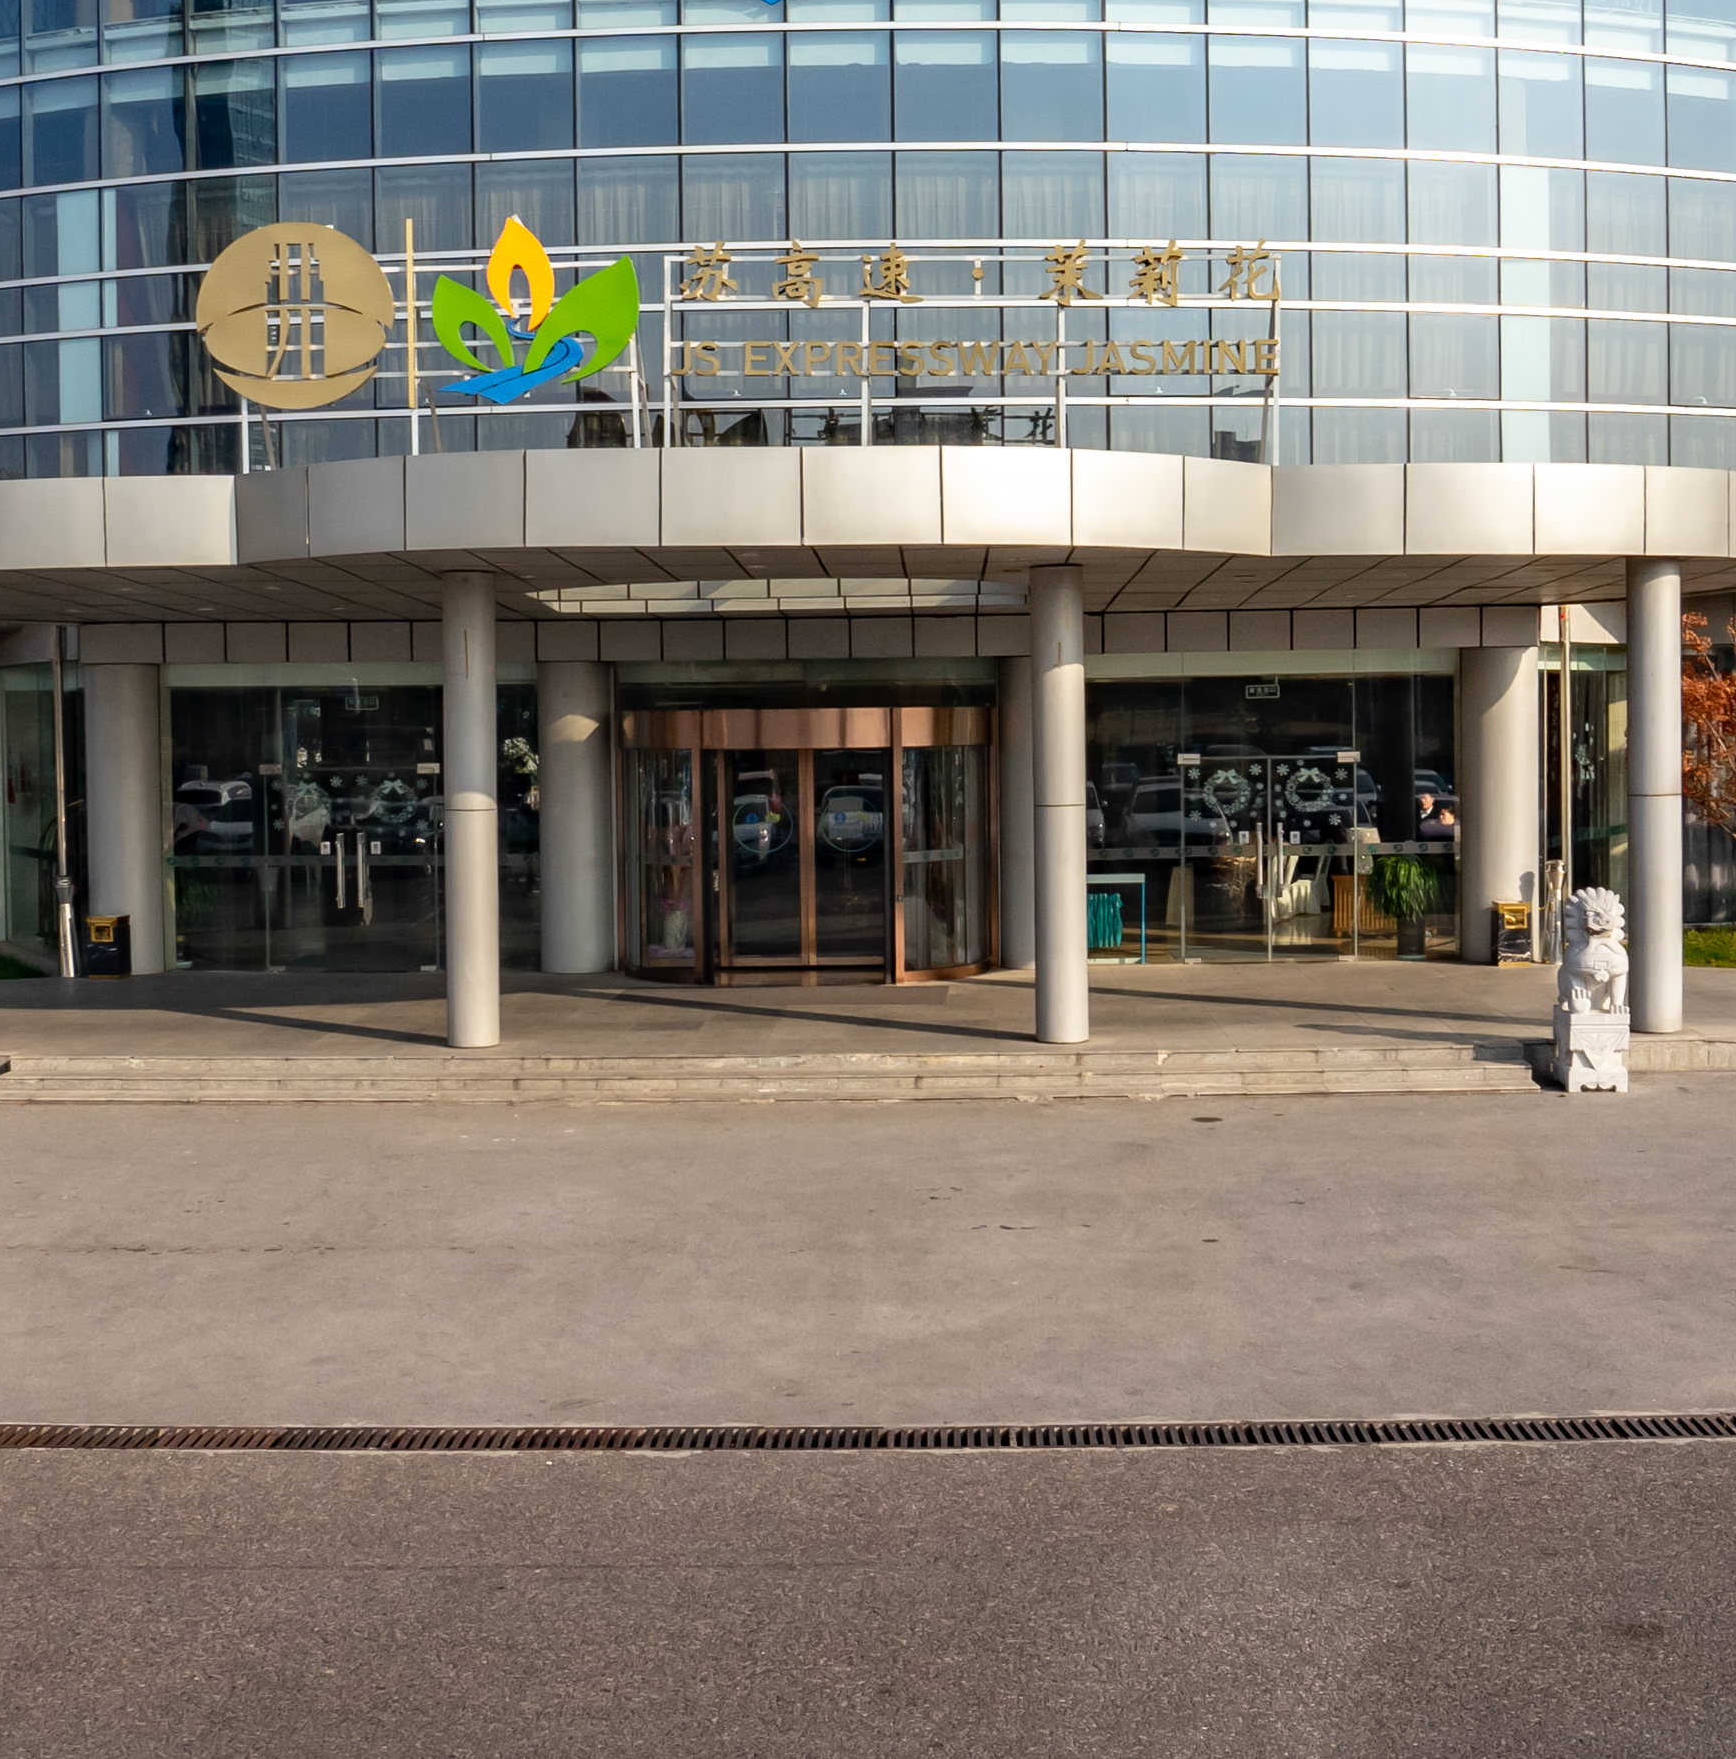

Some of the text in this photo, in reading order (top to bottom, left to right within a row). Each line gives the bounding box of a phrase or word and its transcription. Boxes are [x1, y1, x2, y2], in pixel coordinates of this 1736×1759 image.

[672, 339, 1280, 377] JS EXPRESSWAY JASMINE
